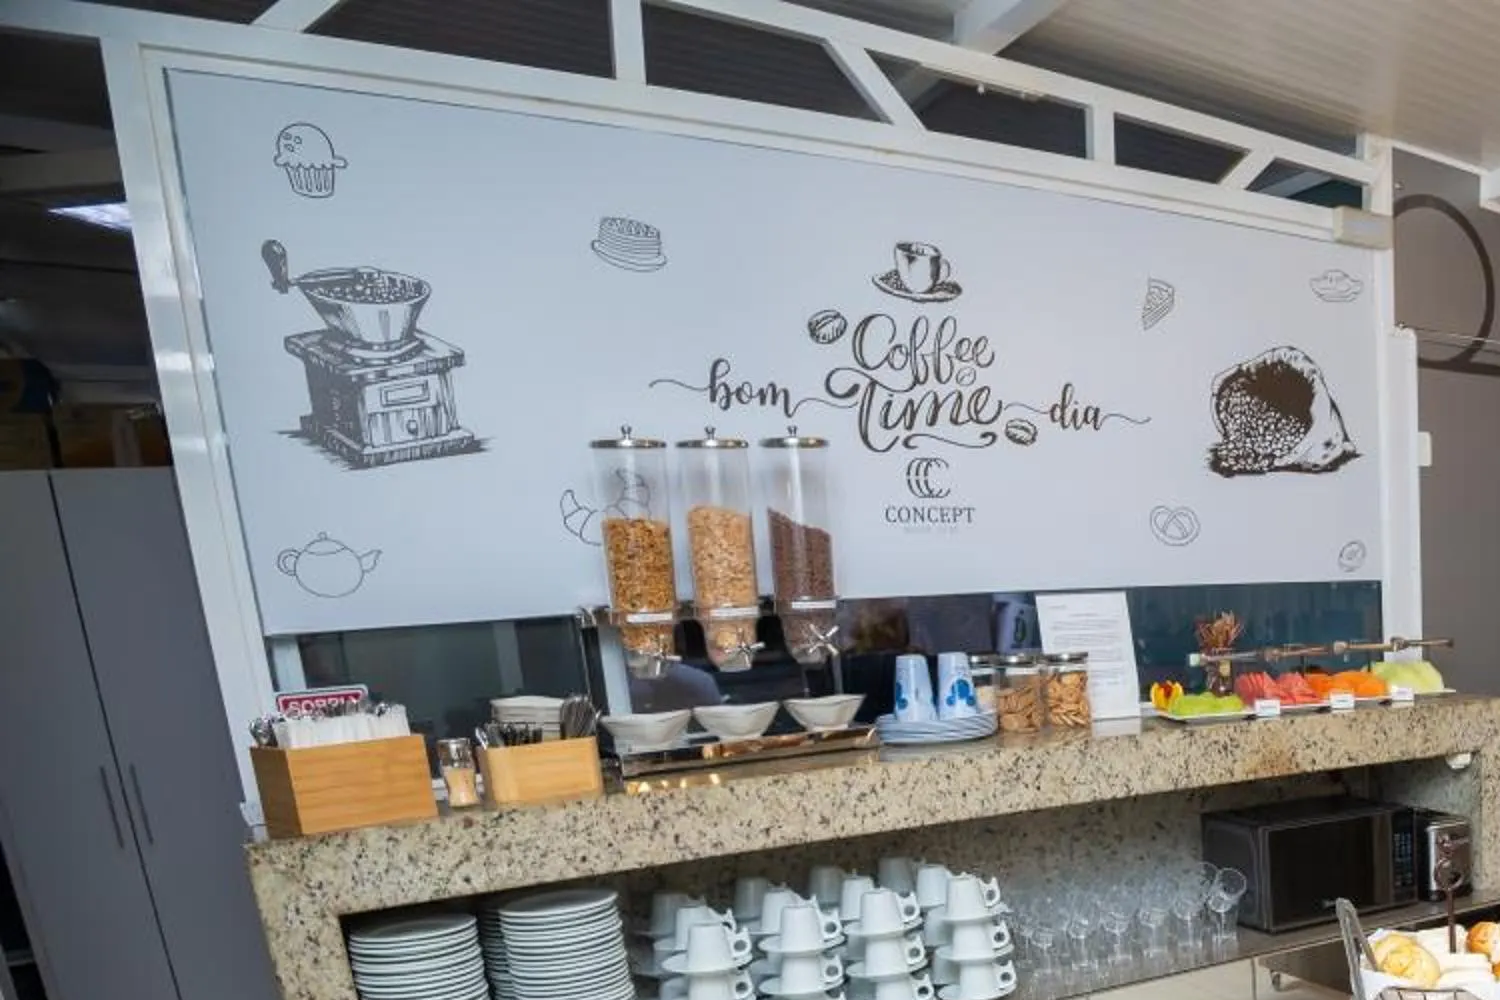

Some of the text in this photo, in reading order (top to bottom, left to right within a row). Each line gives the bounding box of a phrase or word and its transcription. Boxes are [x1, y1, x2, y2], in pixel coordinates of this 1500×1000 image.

[852, 313, 995, 385] Coffee
[709, 357, 793, 418] bom
[826, 367, 1003, 453] Time
[1049, 382, 1102, 431] dia
[885, 505, 977, 523] CONCEPT
